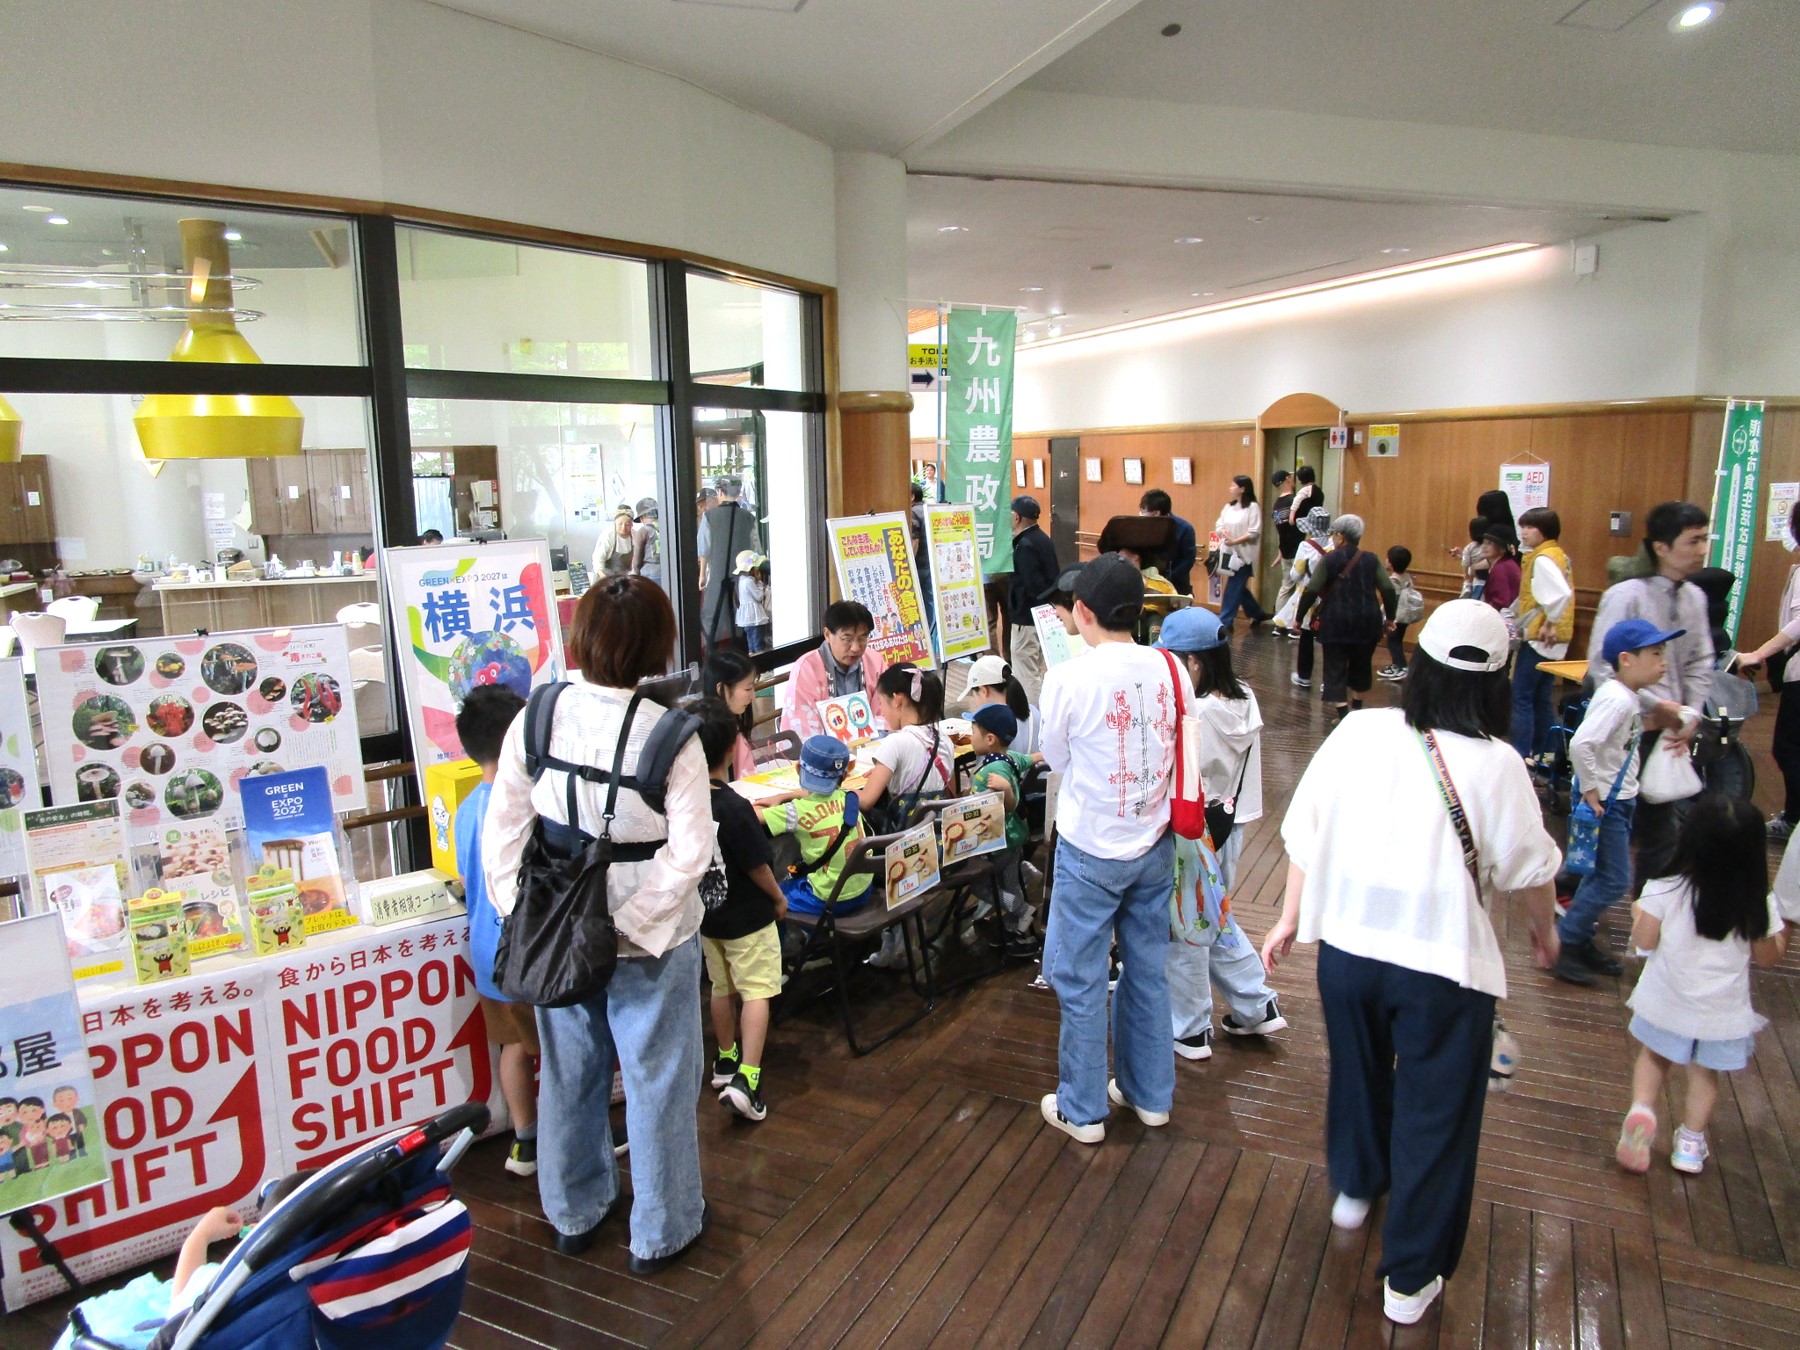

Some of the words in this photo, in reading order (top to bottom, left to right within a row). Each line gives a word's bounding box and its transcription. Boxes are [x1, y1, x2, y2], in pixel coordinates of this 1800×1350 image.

[965, 327, 1001, 560] 九州農政局
[1526, 471, 1545, 484] AED
[265, 782, 304, 796] GREEN
[271, 796, 303, 809] EXPO
[273, 804, 303, 817] 2027
[374, 890, 447, 920] 消費者相談コーナー
[282, 953, 476, 1047] NIPPON
[0, 1031, 62, 1078] 屋
[288, 1017, 436, 1100] FOOD
[291, 1057, 454, 1151] SHIFT
